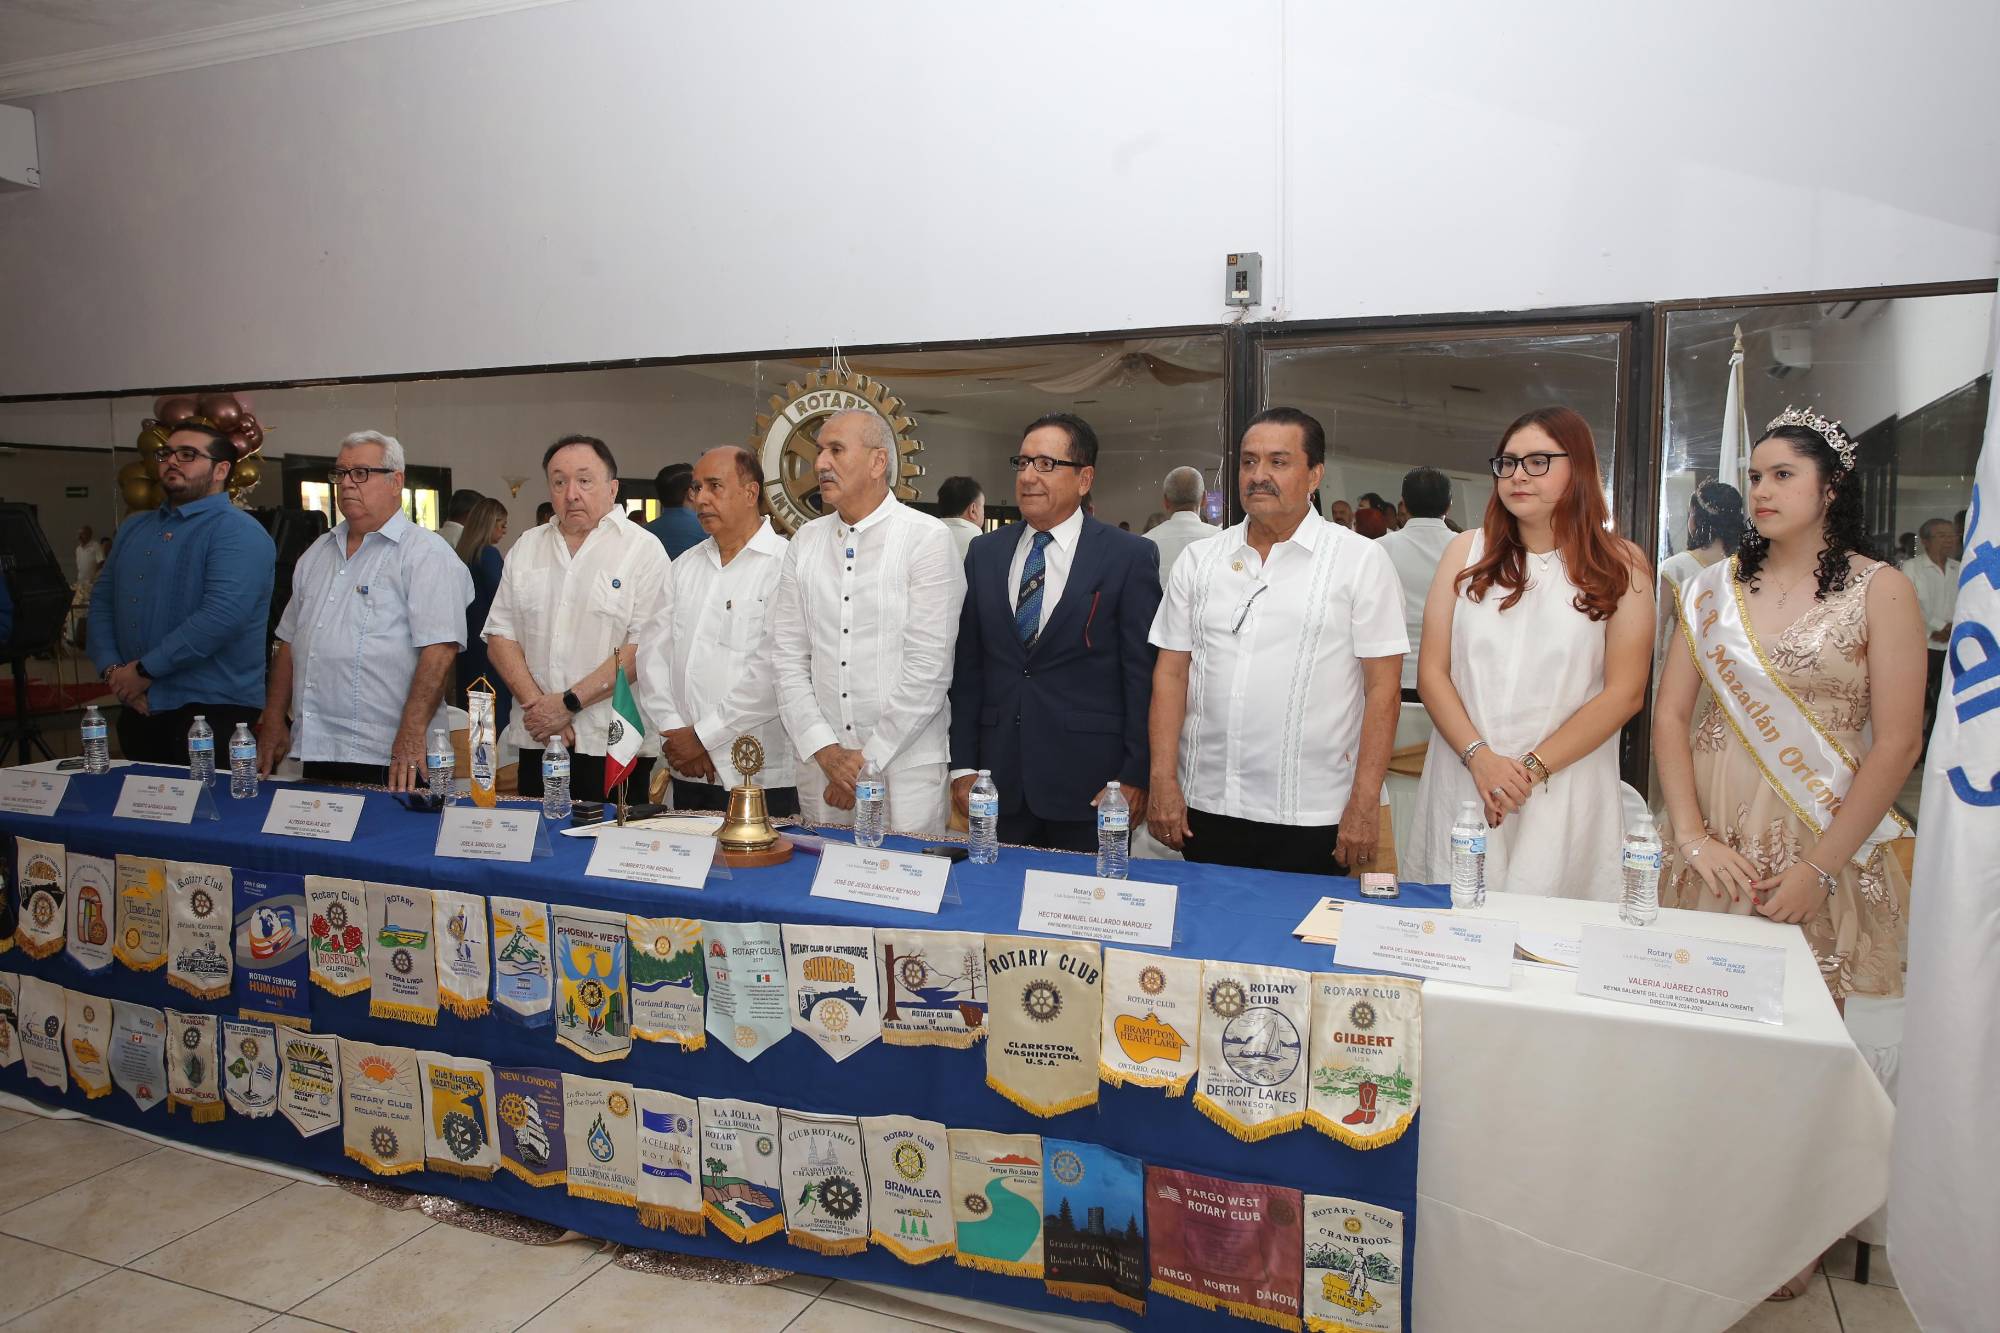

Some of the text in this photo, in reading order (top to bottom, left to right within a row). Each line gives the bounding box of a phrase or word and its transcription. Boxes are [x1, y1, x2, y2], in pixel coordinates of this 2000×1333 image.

[794, 393, 869, 417] ROTARY
[1707, 643, 1781, 744] Mazatlán
[1778, 746, 1841, 818] Orient
[204, 875, 224, 892] Club
[847, 880, 855, 888] DE
[311, 891, 360, 906] Rotary Club
[1073, 887, 1092, 898] Rotary
[387, 895, 414, 909] ROTARY
[500, 909, 521, 920] Rotary
[1063, 913, 1087, 922] MANUEL
[1089, 916, 1121, 926] GALLARDO
[1399, 919, 1420, 931] Rotary
[571, 939, 611, 954] ROTARY CLUB
[732, 947, 782, 957] ROTARY CLUBS
[790, 943, 869, 961] ROTARY CLUB OF LETHBRIDGE
[319, 953, 360, 968] ROSEVILLE
[1647, 948, 1673, 961] Rotary
[803, 956, 856, 984] SUNRISE
[989, 949, 1099, 985] ROTARY CLUB
[249, 972, 297, 988] ROTARY SERVING
[249, 981, 297, 999] HUMANITY
[1249, 983, 1297, 995] ROTARY
[1323, 985, 1401, 1001] ROTARY CLUB
[1629, 977, 1729, 999] VALERIA JUAREZ CASTRO
[634, 998, 702, 1013] Garland Rotary Club
[1127, 995, 1176, 1009] ROTARY CLUB
[1249, 995, 1280, 1006] CLUB
[1603, 985, 1621, 993] REYNA
[1622, 987, 1647, 997] SALIENTE
[1648, 990, 1658, 998] DEL
[1659, 992, 1674, 1000] CLUB
[1675, 995, 1699, 1005] ROTARIO
[1730, 1002, 1754, 1013] ORIENTE
[1650, 999, 1677, 1010] DIRECTIVA
[911, 1010, 953, 1020] ROTARY CLUB
[896, 1023, 912, 1031] BEAR
[1123, 1024, 1176, 1041] BRAMPTON
[1120, 1031, 1180, 1049] HEART LAKE
[1333, 1031, 1395, 1048] GILBERT
[1346, 1046, 1384, 1056] ARIZONA
[1025, 1058, 1060, 1067] U.S.A.
[434, 1070, 448, 1079] Club
[499, 1071, 557, 1090] NEW LONDON
[1150, 1067, 1178, 1079] CANADA
[350, 1093, 413, 1110] ROTARY CLUB
[1206, 1084, 1297, 1104] DETROIT LAKES
[1226, 1099, 1276, 1110] MINNESOTA
[713, 1109, 761, 1122] LA JOLLA
[718, 1119, 761, 1131] CALIFORNIA
[705, 1130, 738, 1141] ROTARY
[788, 1128, 856, 1147] CLUB ROTARIO
[883, 1130, 935, 1151] ROTARY CLUB
[710, 1142, 733, 1152] CLUB
[641, 1150, 691, 1170] ROTARY
[652, 1168, 667, 1178] 100
[990, 1166, 1039, 1179] Tempe Rio Salado
[884, 1179, 942, 1199] BRAMALEA
[1186, 1188, 1261, 1208] FARGO WEST
[1187, 1200, 1262, 1222] ROTARY CLUB
[1311, 1207, 1394, 1230] ROTARY CLUB
[1049, 1240, 1078, 1249] Grande
[1319, 1228, 1393, 1246] CRANBROOK
[1118, 1263, 1139, 1284] Five
[1158, 1266, 1299, 1310] FARGO NORTH DAKOTA
